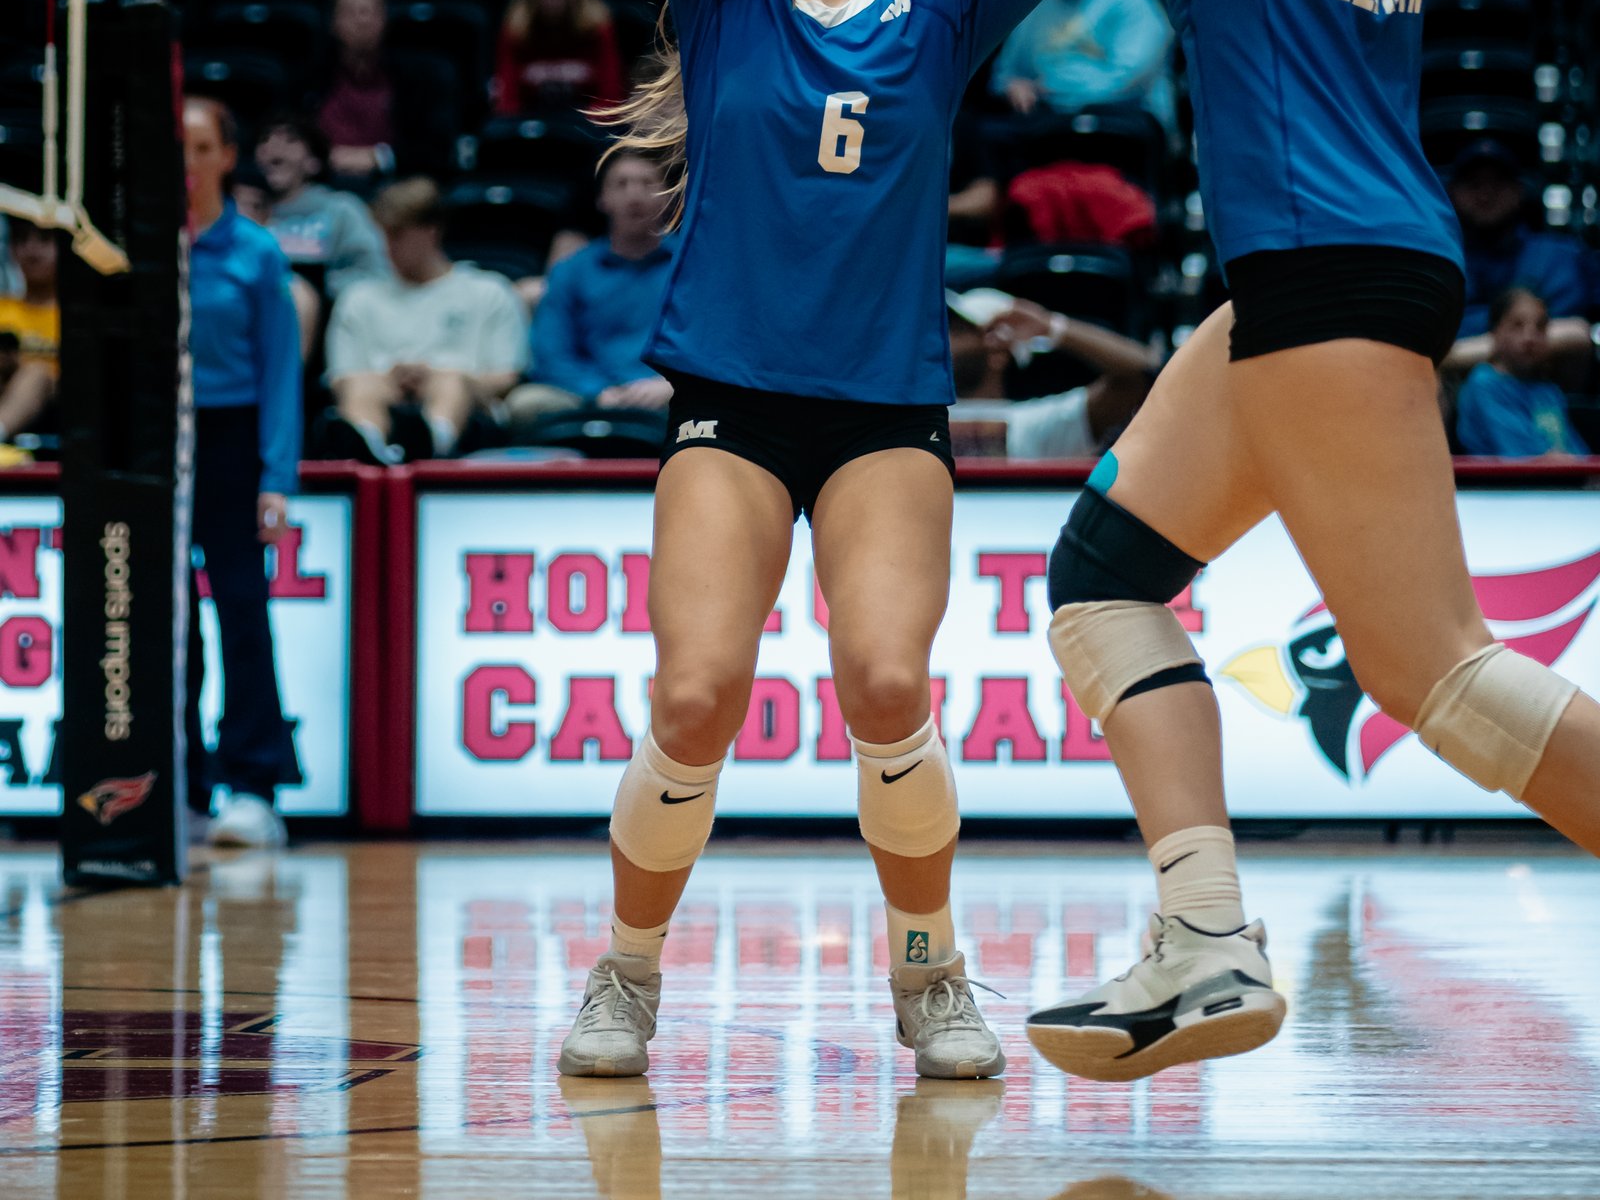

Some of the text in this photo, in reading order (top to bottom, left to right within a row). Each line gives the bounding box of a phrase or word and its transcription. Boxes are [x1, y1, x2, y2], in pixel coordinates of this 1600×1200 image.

[817, 91, 870, 175] 6
[99, 521, 134, 741] sports imports
